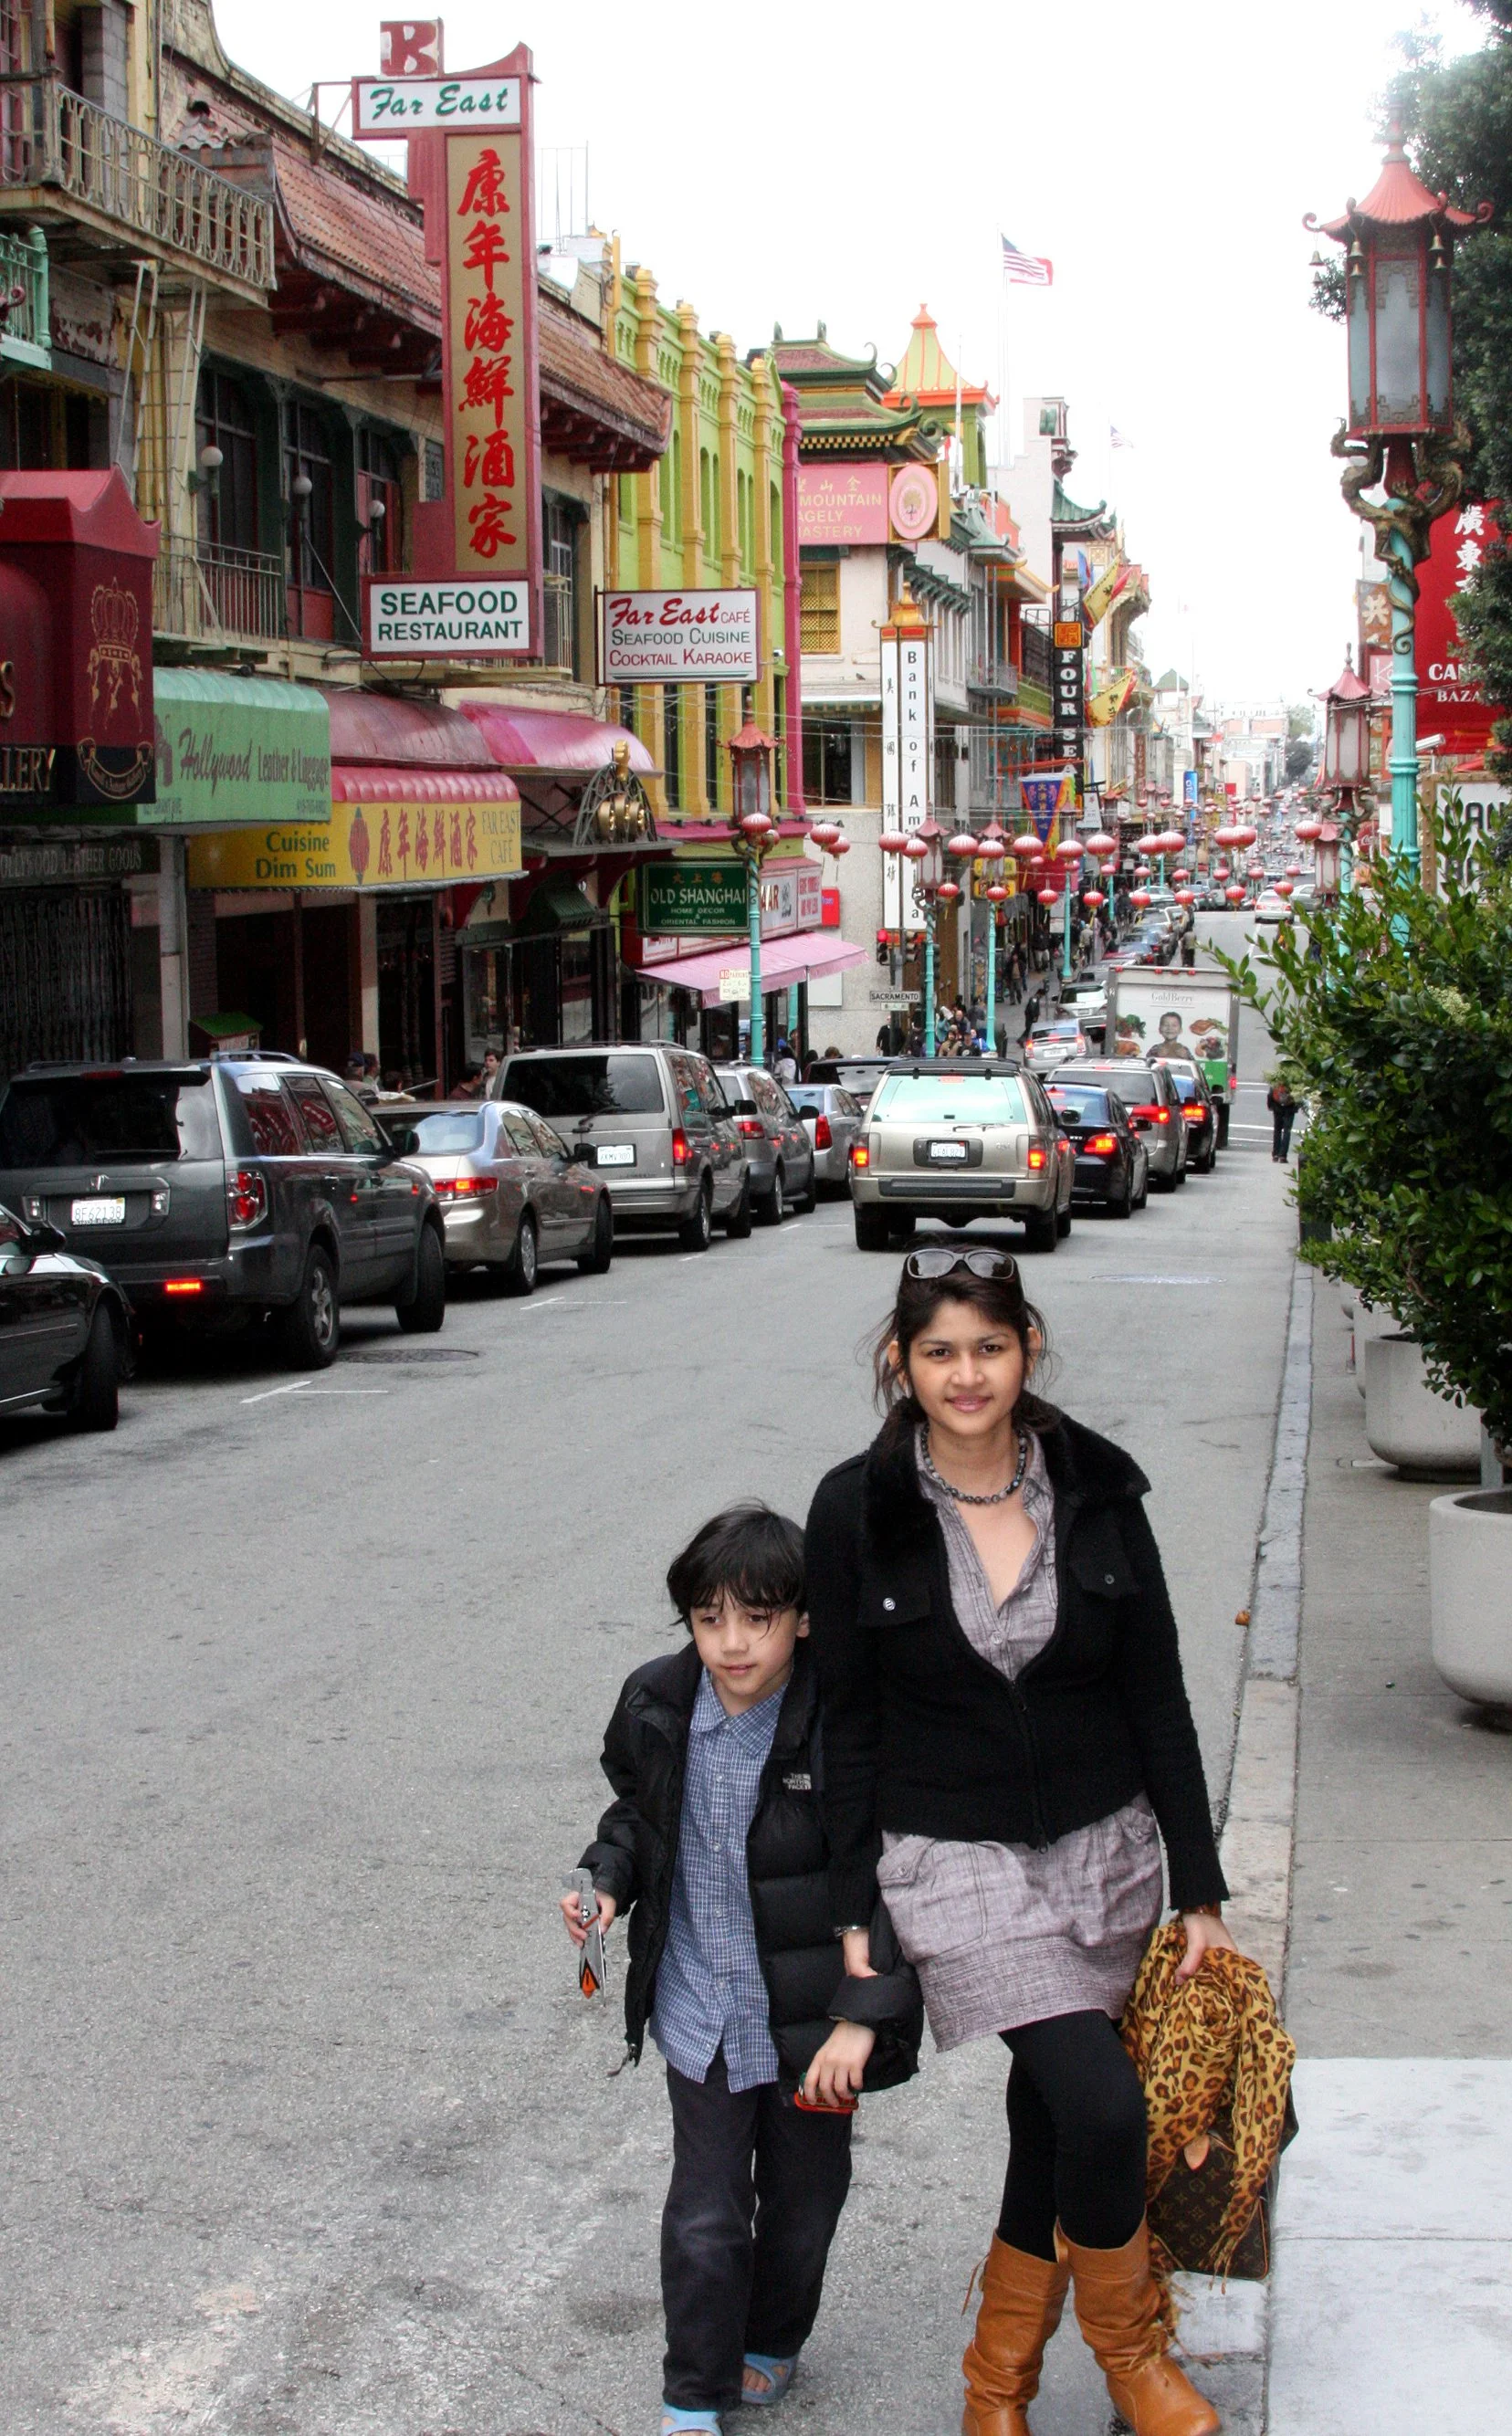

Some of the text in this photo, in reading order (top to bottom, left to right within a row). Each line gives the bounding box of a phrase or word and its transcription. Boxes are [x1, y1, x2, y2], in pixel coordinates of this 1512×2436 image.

[370, 84, 508, 121] Far East
[800, 493, 882, 507] MOUNTAIN
[798, 509, 844, 522] AGELY
[798, 525, 863, 539] ASTERY
[380, 590, 518, 615] SEAFOOD
[609, 597, 751, 628] Far East CAFÉ
[378, 621, 523, 641] RESTAURANT
[612, 627, 751, 646] SEAFOOD CUISINE
[610, 648, 752, 667] COCKTAIL KARAOKE
[908, 651, 918, 721] Bank
[1060, 650, 1077, 716] FOUR
[178, 728, 253, 798] Hollywood
[258, 746, 289, 782] Leather
[299, 749, 329, 793] Luggage
[909, 740, 918, 772] of
[482, 809, 520, 835] FAR EAST
[266, 830, 330, 852] Cuisine
[109, 846, 142, 872] GOODS
[255, 857, 336, 878] Dim Sum
[650, 887, 746, 905] OLD SHANGHAI
[871, 992, 919, 1001] SACRAMENTO
